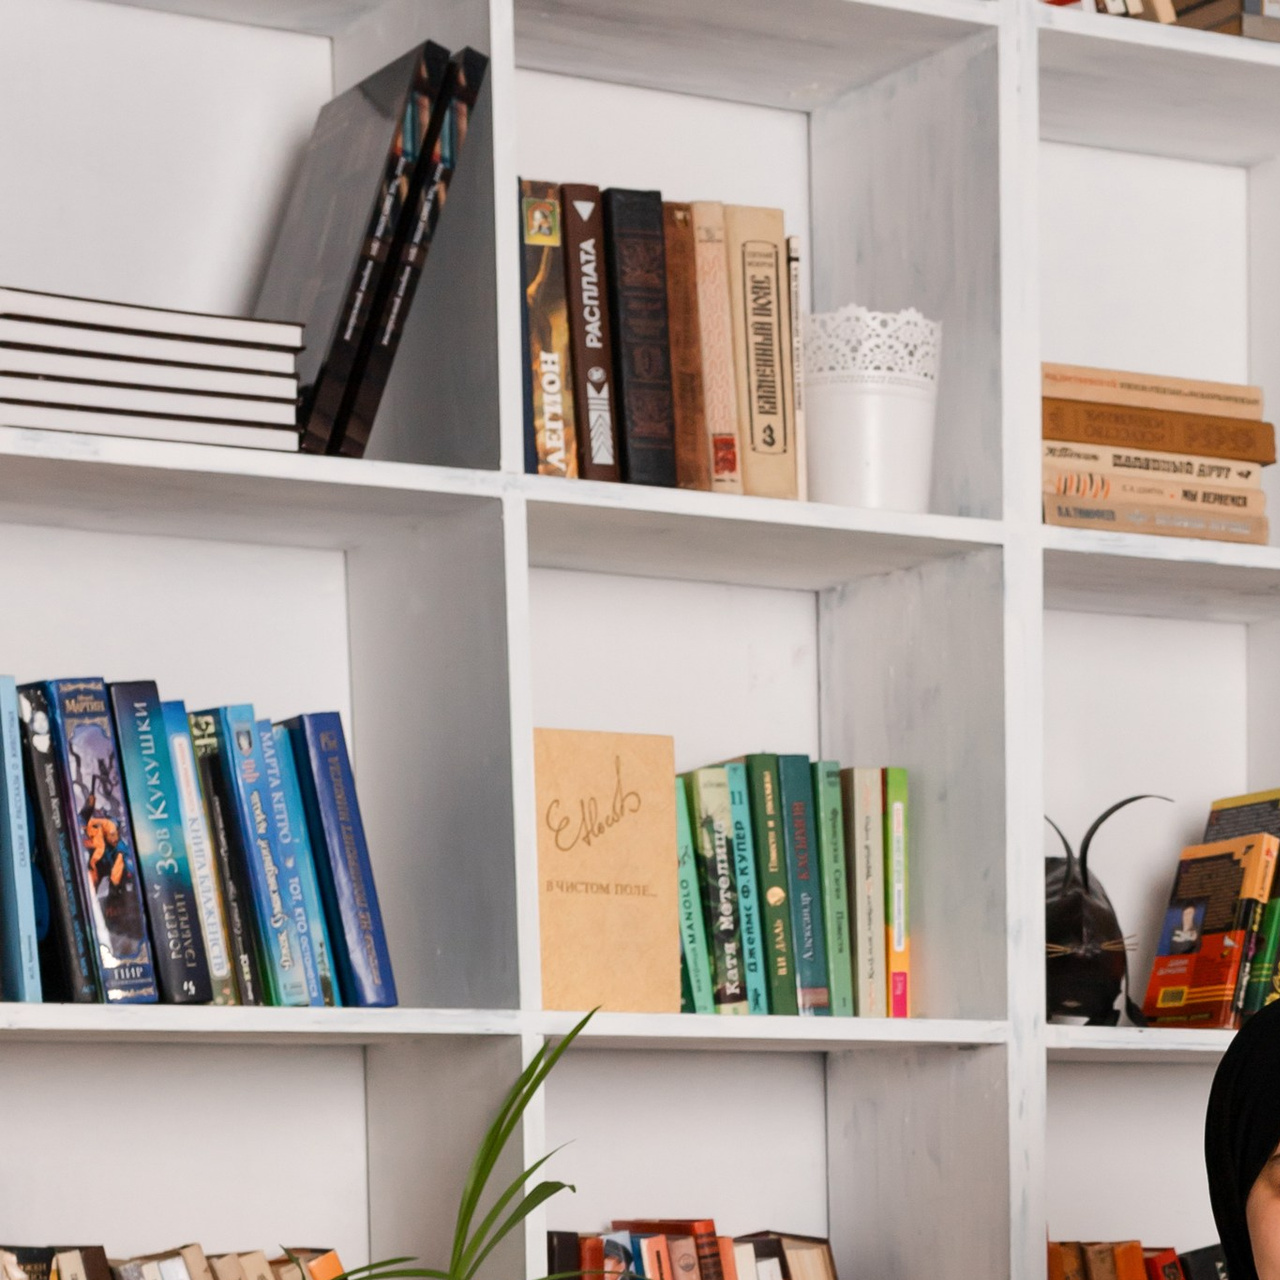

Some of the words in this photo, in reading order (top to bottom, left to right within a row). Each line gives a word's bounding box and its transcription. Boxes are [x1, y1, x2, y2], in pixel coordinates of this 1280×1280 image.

[578, 238, 603, 349] РАСПЛАТА
[750, 320, 778, 415] КАМЕННЫЙ
[539, 350, 567, 472] ЛЕГИОН
[761, 423, 775, 447] 3
[257, 729, 282, 788] МАРТА
[186, 816, 208, 871] КНИГА
[268, 790, 294, 845] КЕТРО
[828, 807, 842, 864] Франсуаза
[733, 818, 749, 876] КУПЕР
[546, 879, 554, 893] В
[556, 880, 611, 895] ЧИСТОМ
[678, 877, 698, 945] MANOLO
[832, 868, 843, 900] Саган
[159, 900, 184, 959] РОБЕРТ
[196, 873, 226, 973] БЛАЖЕНСТВ
[292, 906, 309, 934] КТО
[798, 891, 817, 961] Александр
[834, 910, 846, 954] Повести
[720, 940, 741, 995] Катя
